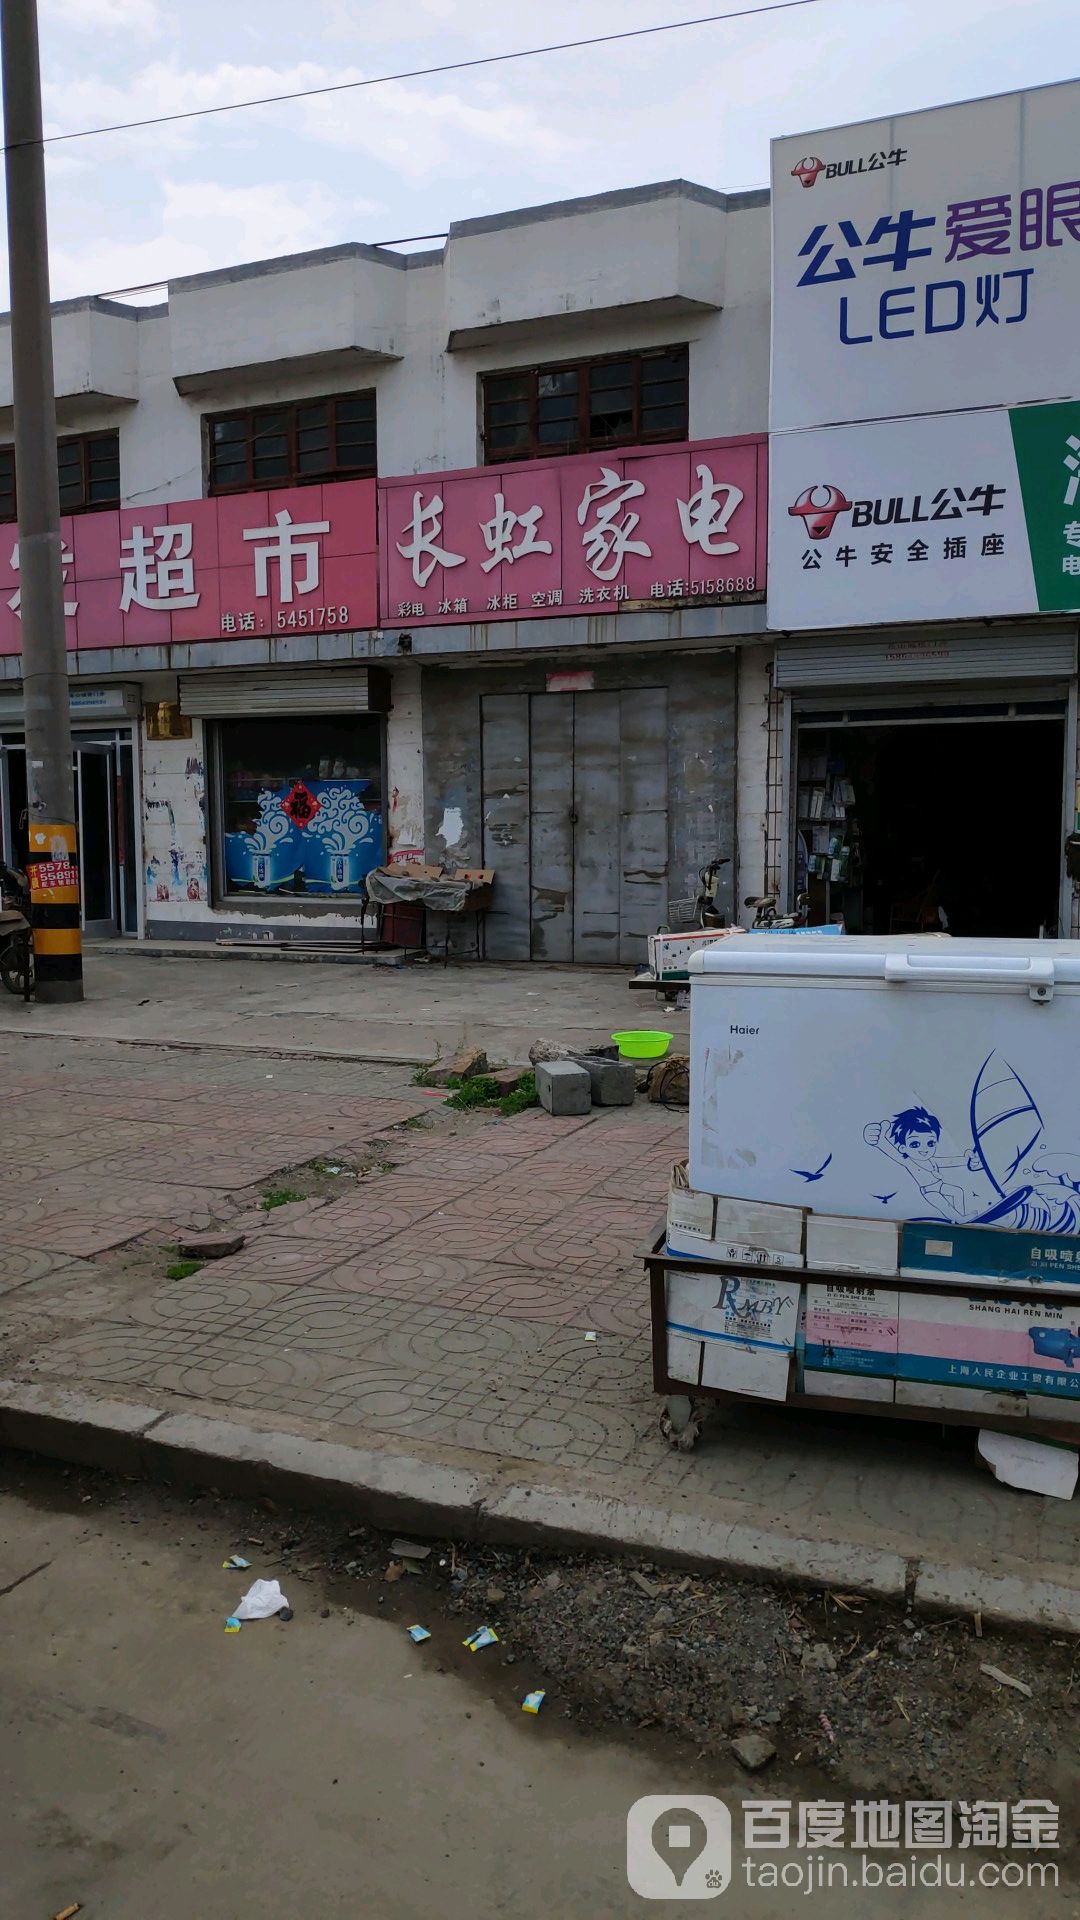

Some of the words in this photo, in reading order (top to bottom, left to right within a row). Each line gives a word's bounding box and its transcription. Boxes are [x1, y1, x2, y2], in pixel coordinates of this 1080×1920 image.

[825, 148, 908, 179] BULL公牛
[839, 268, 1035, 345] LED灯
[851, 484, 1007, 528] BULL公牛
[395, 464, 745, 588] 长虹家电
[7, 510, 330, 613] 超市
[801, 533, 1005, 570] 公牛安全插座
[397, 601, 425, 617] 彩电
[438, 598, 468, 614] 冰箱
[486, 593, 518, 611] 冰柜
[530, 589, 563, 608] 空调
[578, 584, 630, 604] 洗衣机
[730, 1024, 760, 1035] Haier
[969, 1304, 1001, 1313] SHANG
[1023, 1309, 1041, 1317] REN
[1044, 1311, 1063, 1319] MIN
